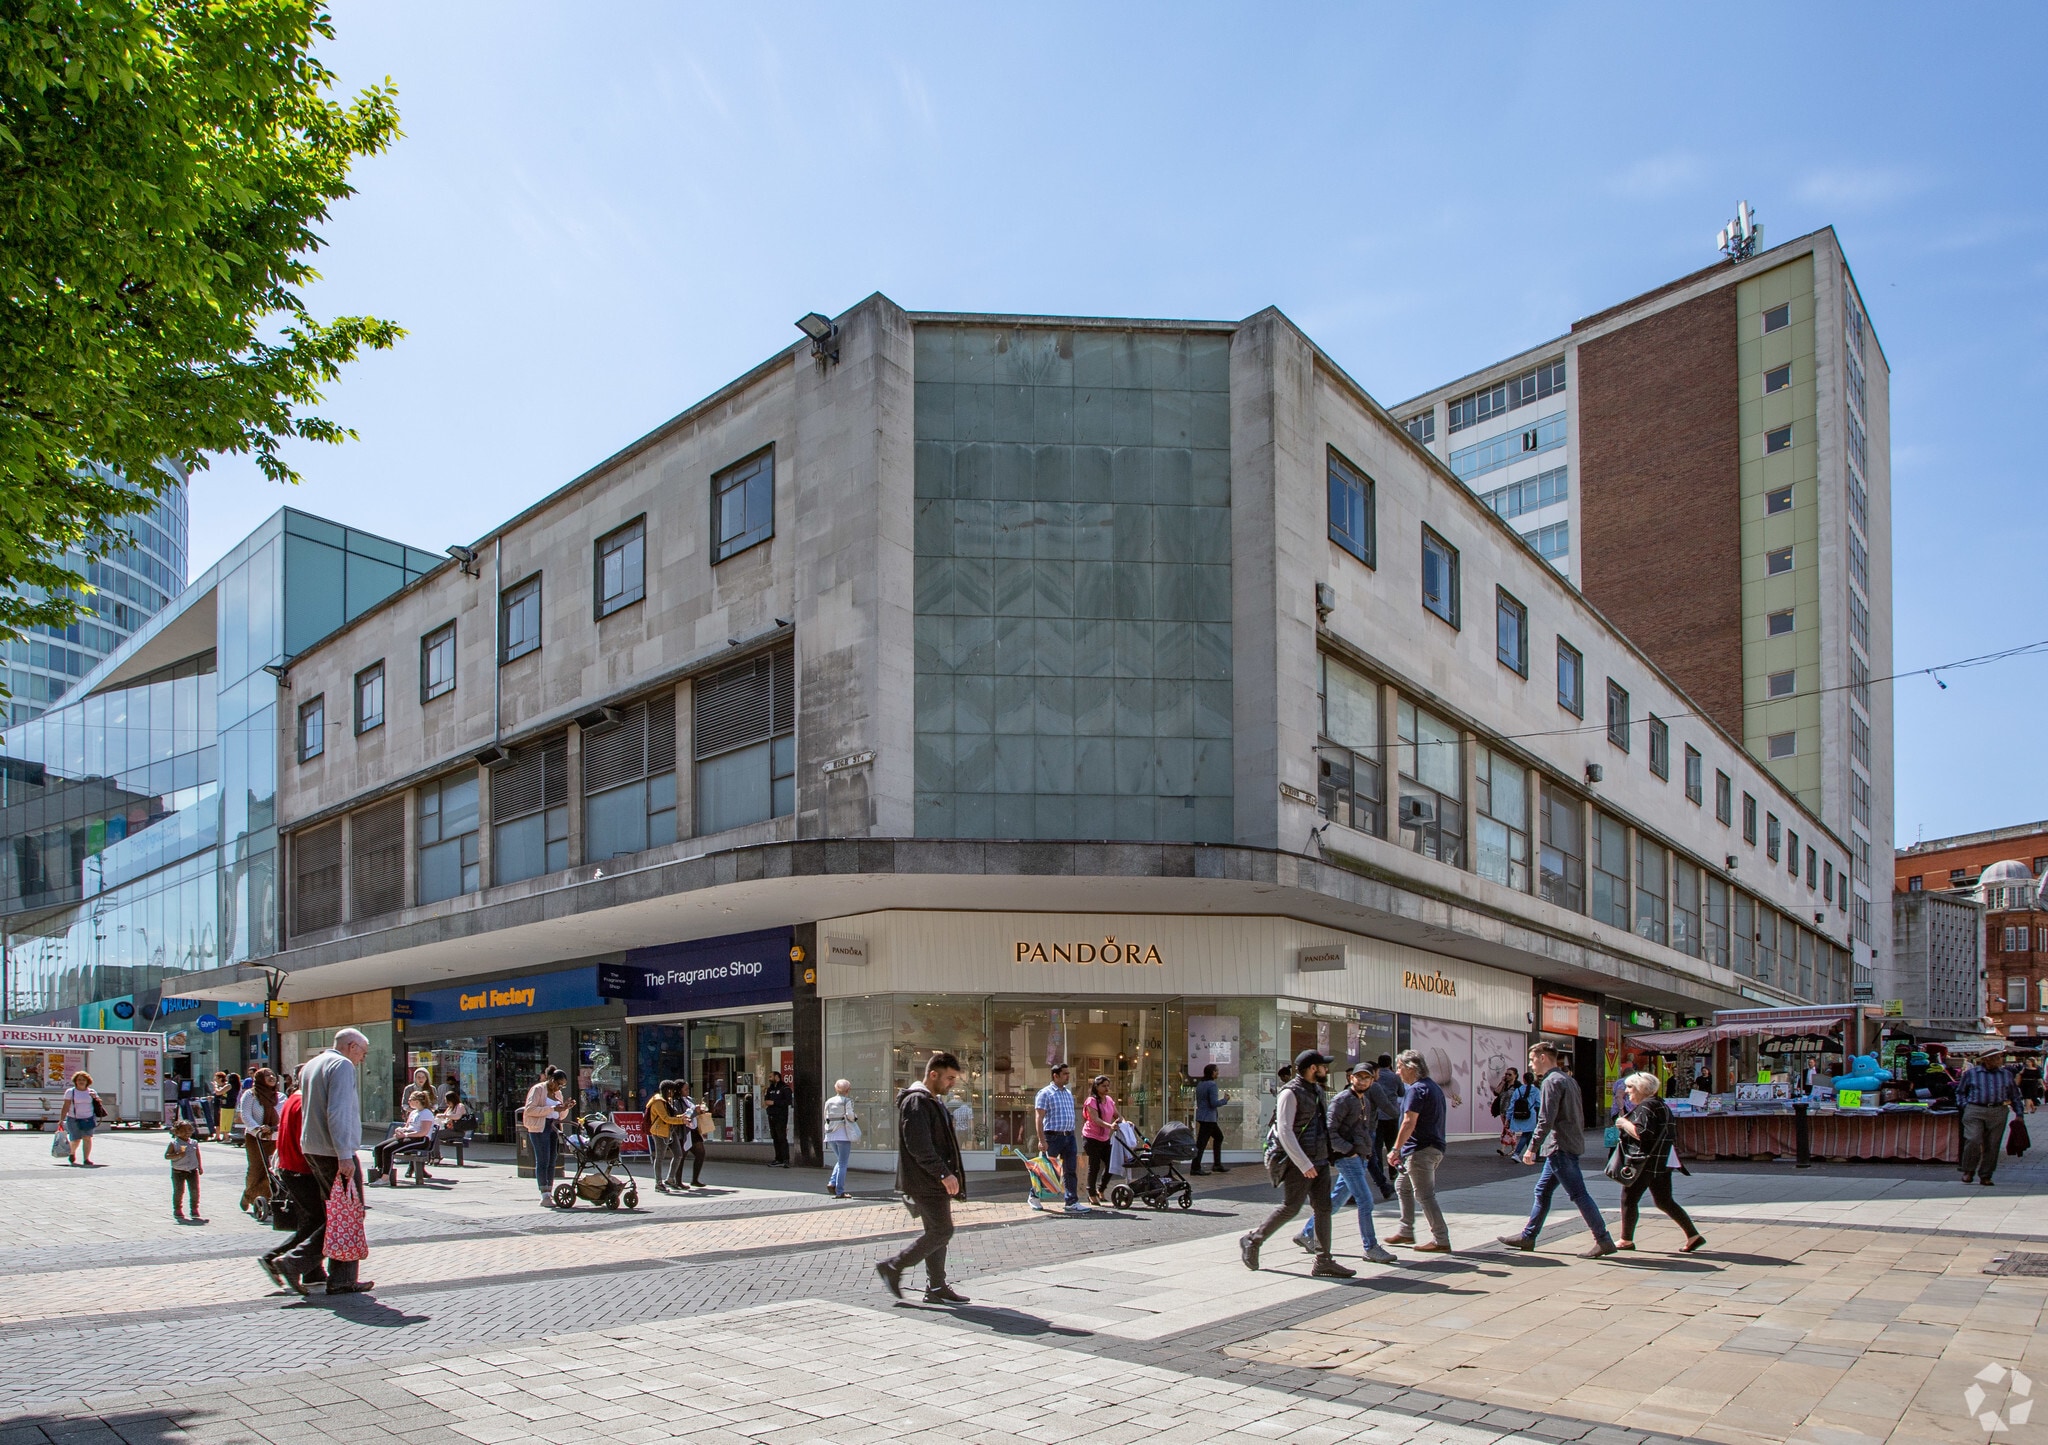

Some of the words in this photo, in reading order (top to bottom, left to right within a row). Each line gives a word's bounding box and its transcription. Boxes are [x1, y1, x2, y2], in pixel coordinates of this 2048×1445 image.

[832, 946, 863, 957] PANDORA
[1016, 941, 1163, 965] PANDORA
[1304, 953, 1340, 963] PANDORA
[603, 976, 626, 984] Fragrance
[644, 973, 666, 987] The
[667, 965, 728, 985] Fragrance
[729, 961, 763, 977] Shop
[1404, 971, 1457, 997] PANDORA
[459, 991, 487, 1011] Card
[490, 987, 536, 1007] Factory
[2, 1031, 65, 1042] FRESHLY
[68, 1034, 105, 1045] MADE
[108, 1036, 159, 1047] DONUTS
[1128, 1037, 1162, 1049] PADOR
[1765, 1039, 1824, 1053] delhi
[1843, 1092, 1858, 1105] £2
